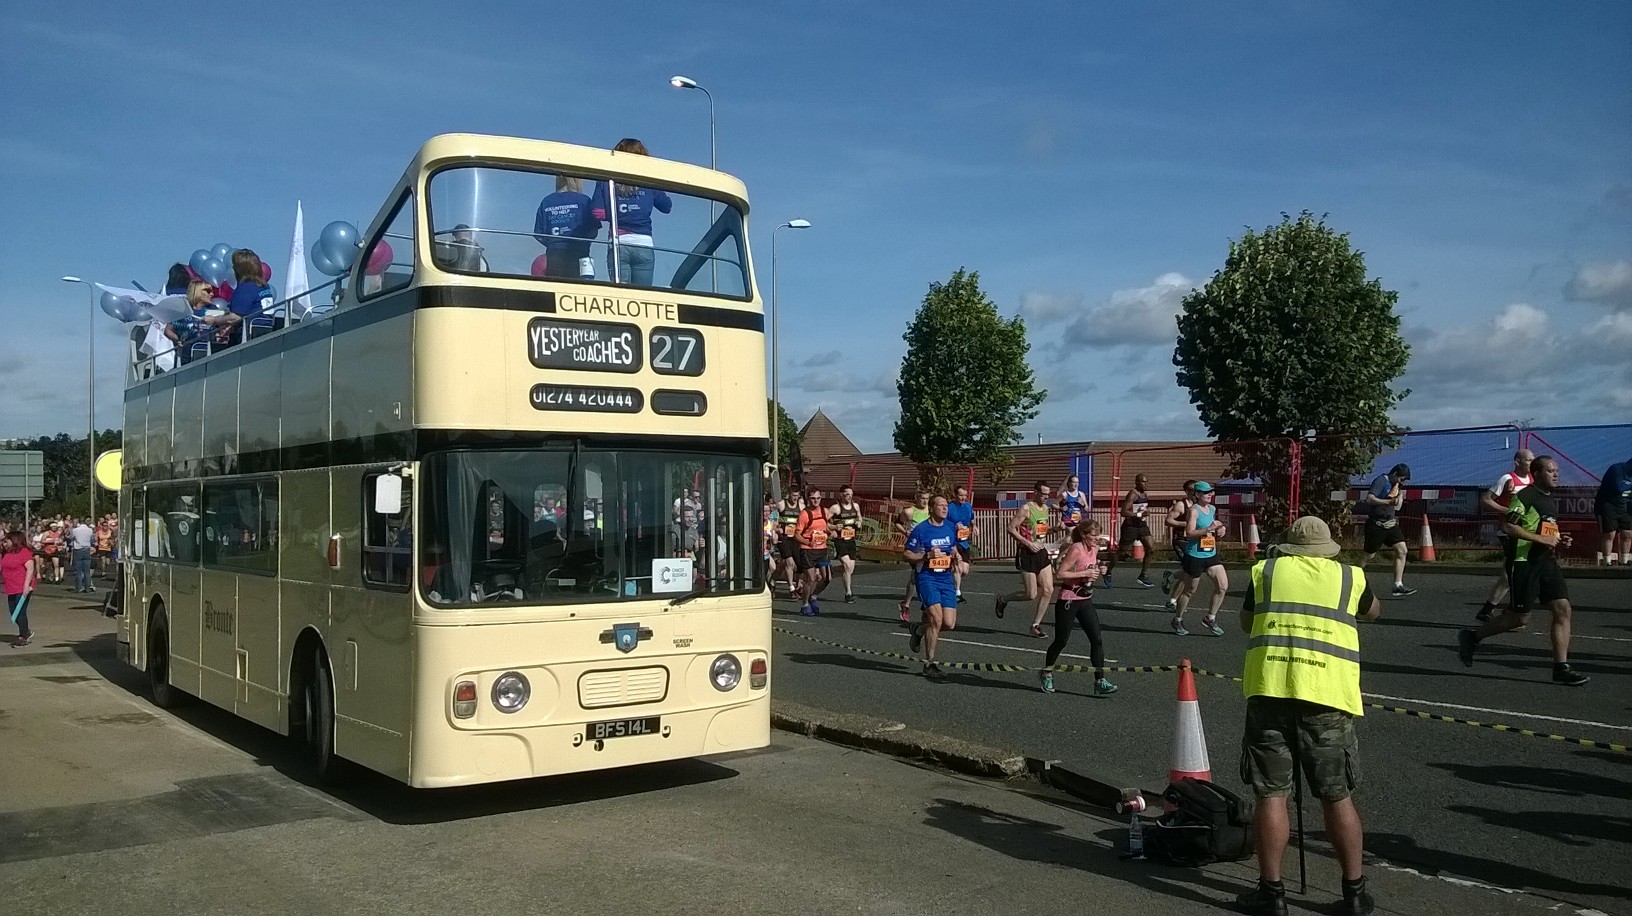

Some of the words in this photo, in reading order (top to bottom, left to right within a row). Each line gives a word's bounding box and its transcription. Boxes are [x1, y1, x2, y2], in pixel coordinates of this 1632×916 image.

[558, 294, 677, 322] CHARLOTTE
[530, 325, 600, 360] YESTERYEAR
[572, 331, 633, 366] COACHES
[651, 334, 697, 371] 27
[932, 559, 949, 567] 9438
[672, 637, 694, 645] SCREEN
[1266, 655, 1289, 663] OFFICIAL
[1288, 655, 1327, 669] PHOTOGRAPHER
[595, 721, 626, 739] BFS
[628, 719, 652, 736] 14L
